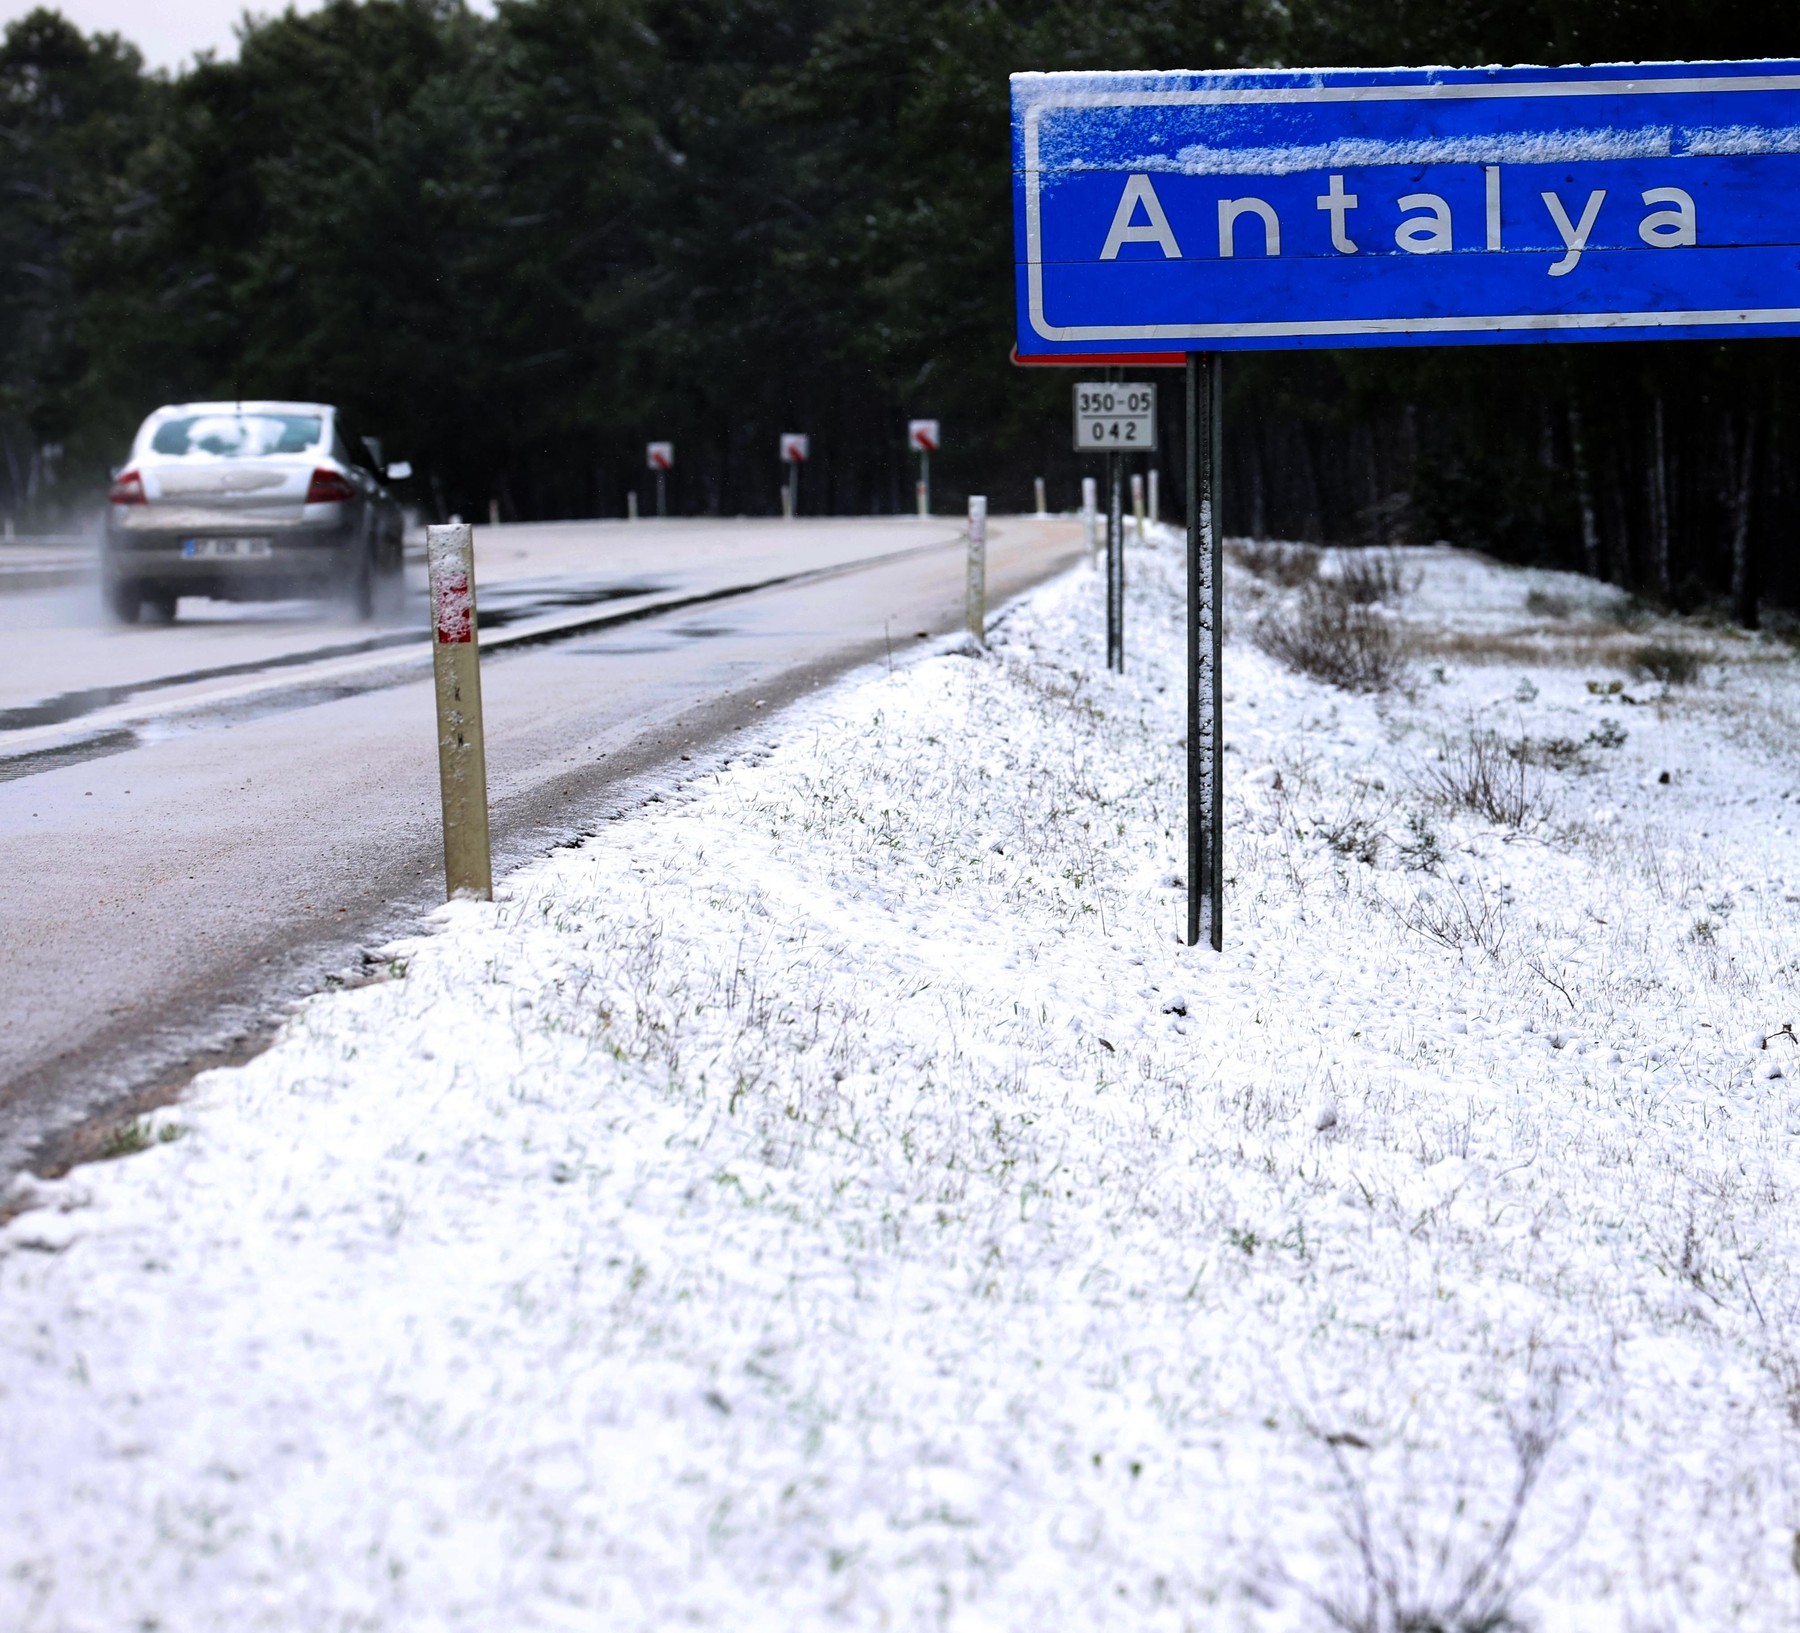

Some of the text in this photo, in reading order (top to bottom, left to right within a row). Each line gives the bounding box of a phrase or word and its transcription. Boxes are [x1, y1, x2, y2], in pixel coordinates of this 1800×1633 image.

[1099, 165, 1698, 277] Antalya
[1080, 392, 1151, 412] 350-05
[1092, 421, 1137, 441] 042
